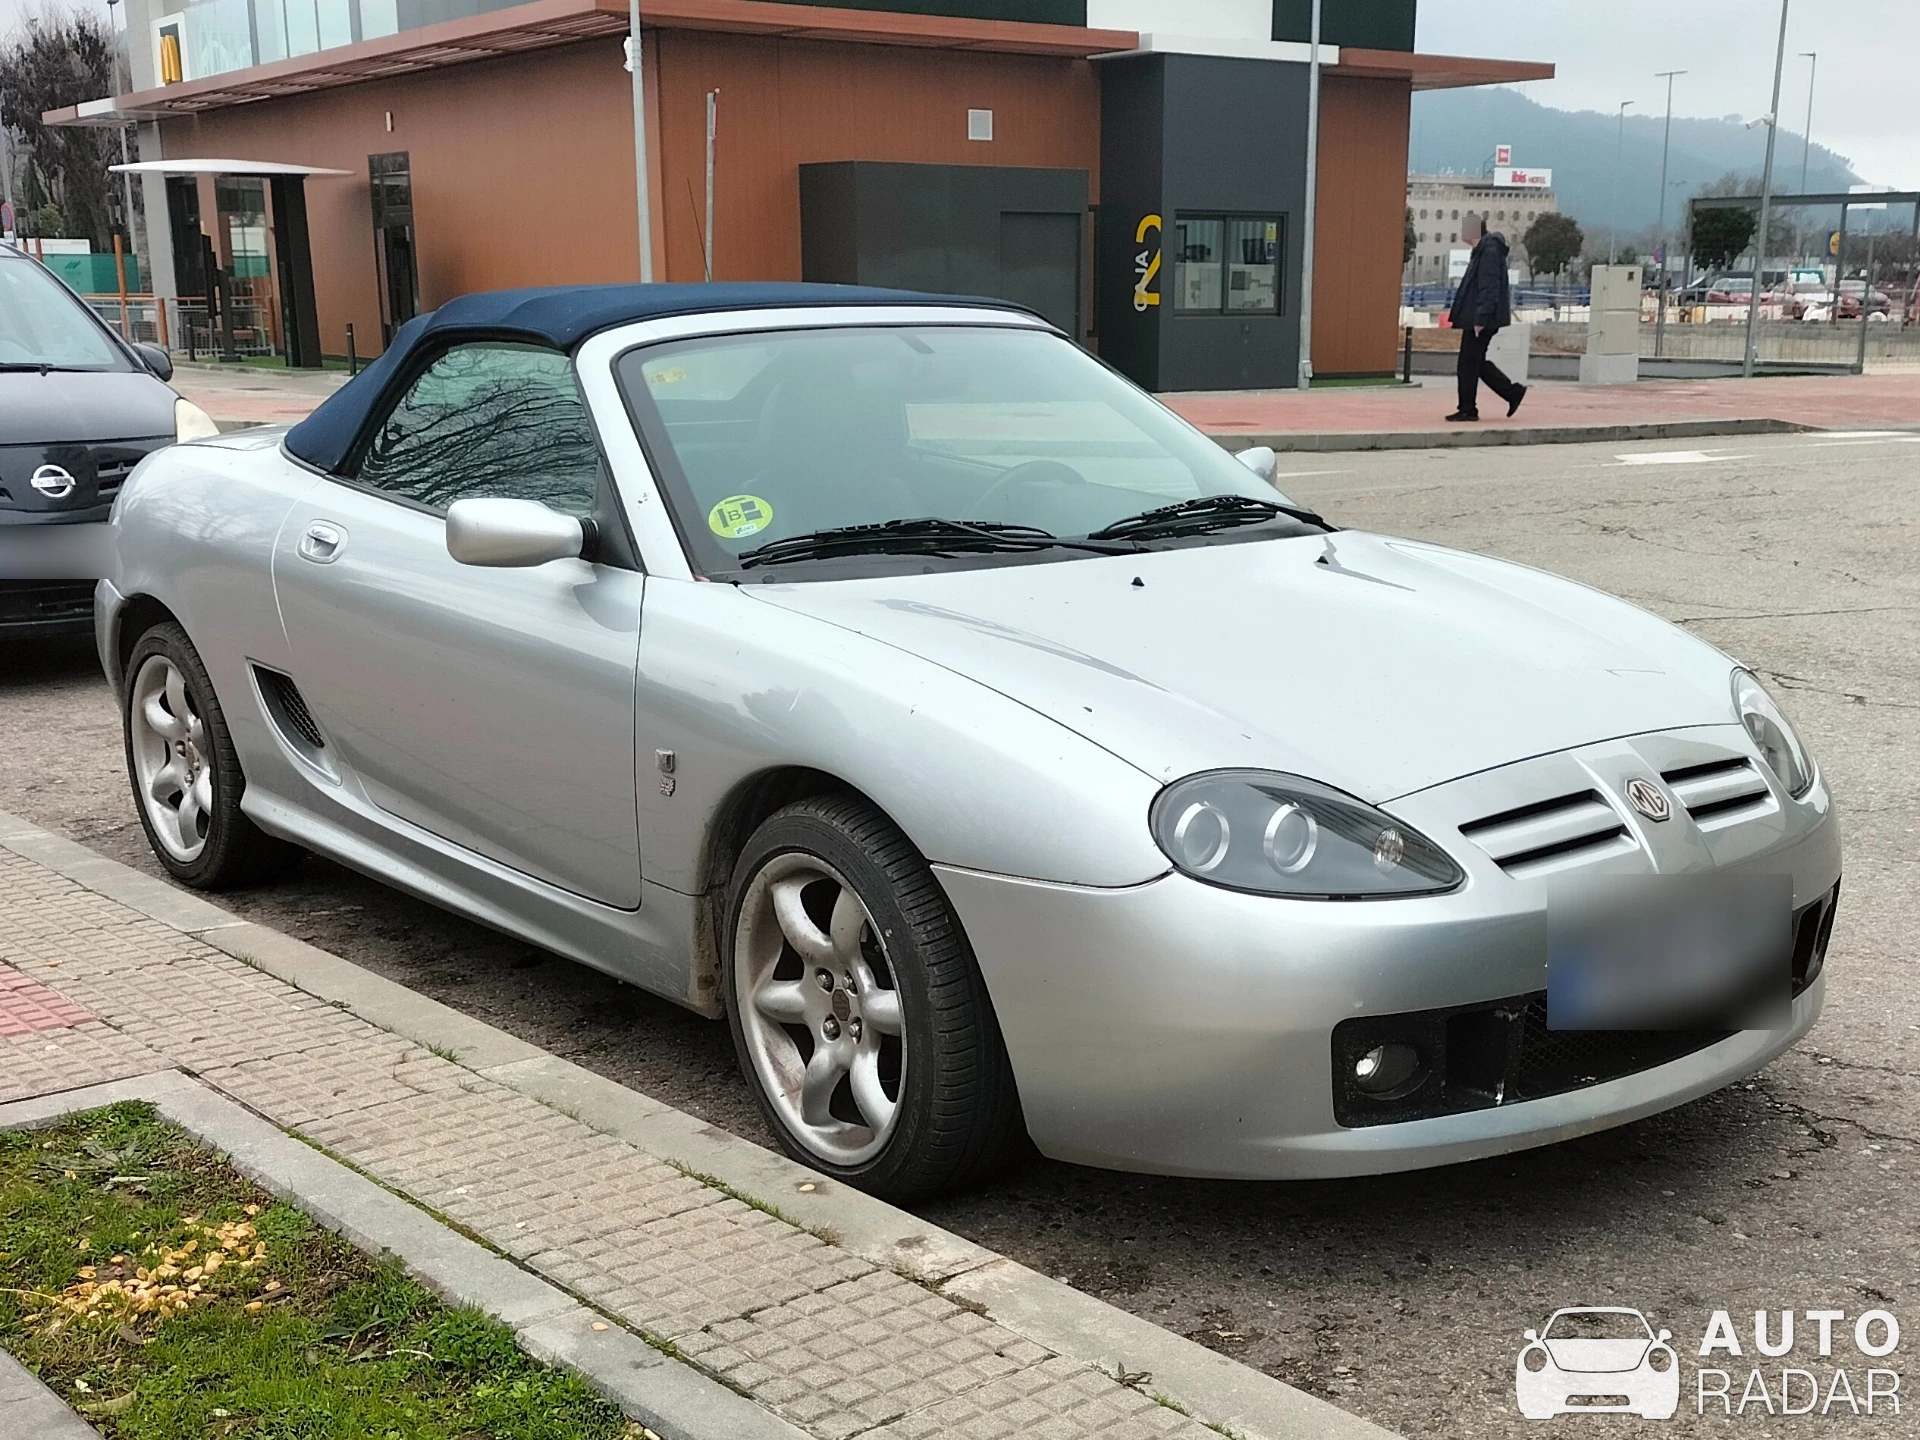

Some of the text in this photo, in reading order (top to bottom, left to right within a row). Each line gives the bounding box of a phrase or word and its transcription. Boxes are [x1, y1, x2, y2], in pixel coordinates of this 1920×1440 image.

[1135, 214, 1161, 306] 2
[727, 509, 742, 522] B
[1631, 781, 1666, 816] MG
